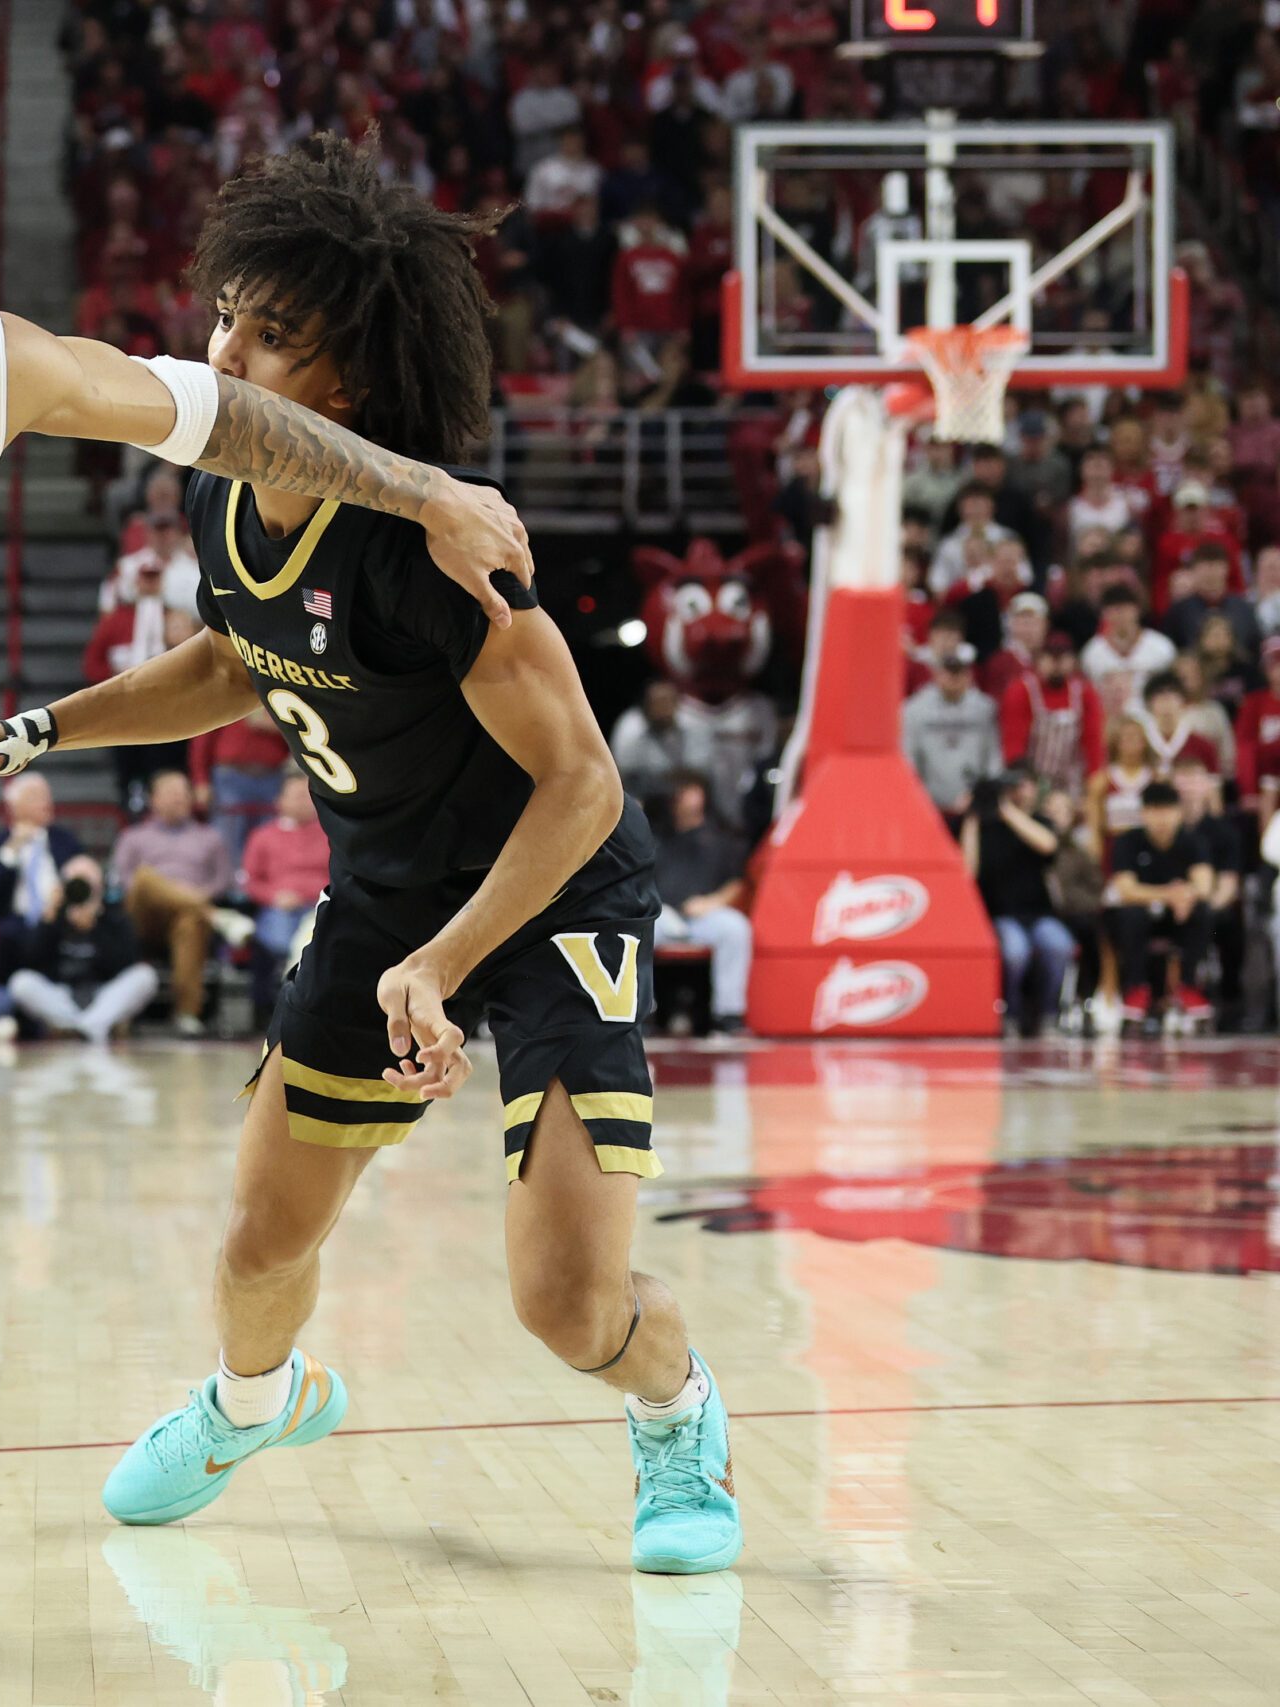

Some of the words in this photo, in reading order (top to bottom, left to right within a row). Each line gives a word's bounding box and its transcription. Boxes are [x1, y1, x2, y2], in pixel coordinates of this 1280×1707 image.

[225, 619, 360, 692] NDERBILT
[267, 688, 357, 794] 3
[549, 932, 640, 1022] V
